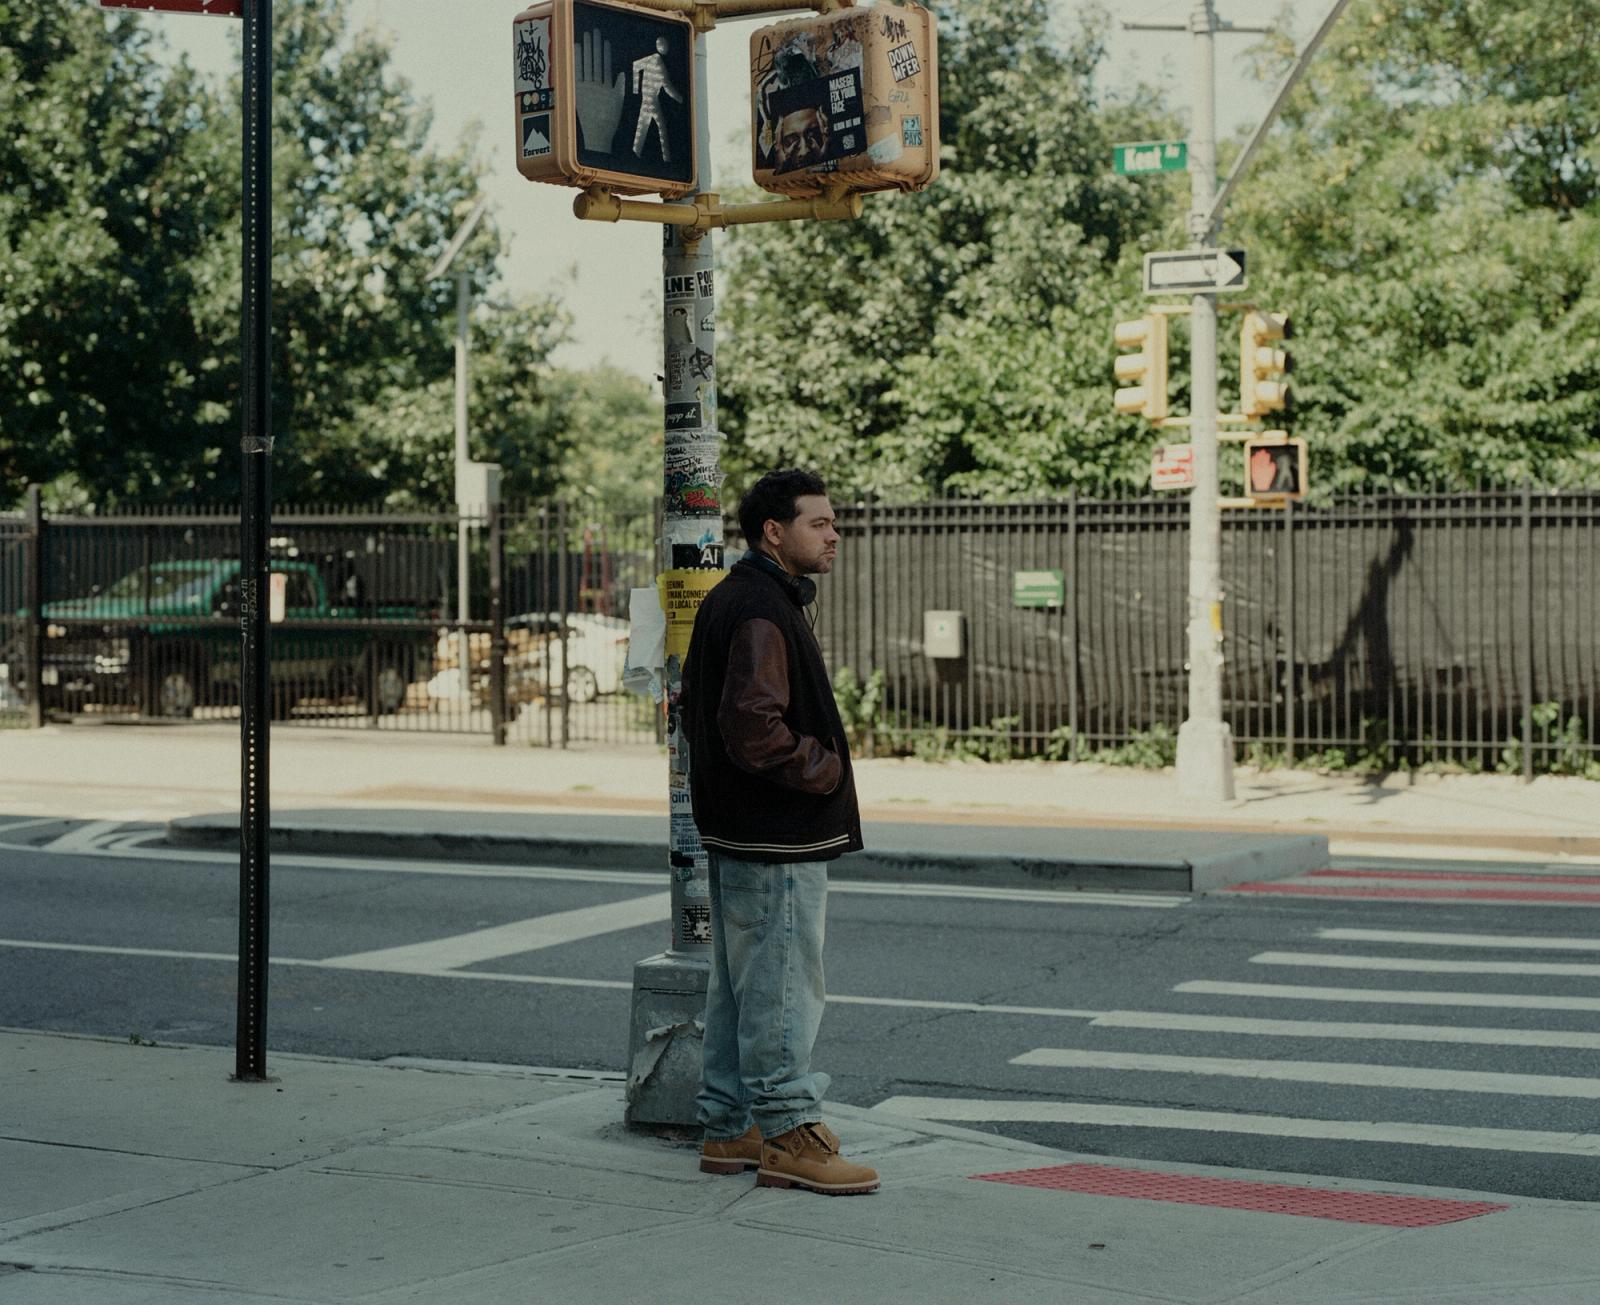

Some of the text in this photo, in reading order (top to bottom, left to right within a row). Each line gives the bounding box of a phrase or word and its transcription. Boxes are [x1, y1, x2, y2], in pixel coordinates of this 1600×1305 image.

[889, 42, 917, 67] DOWN
[892, 57, 920, 81] MFER
[830, 90, 841, 103] FIX
[831, 100, 846, 115] FACE
[523, 145, 550, 157] Forvert
